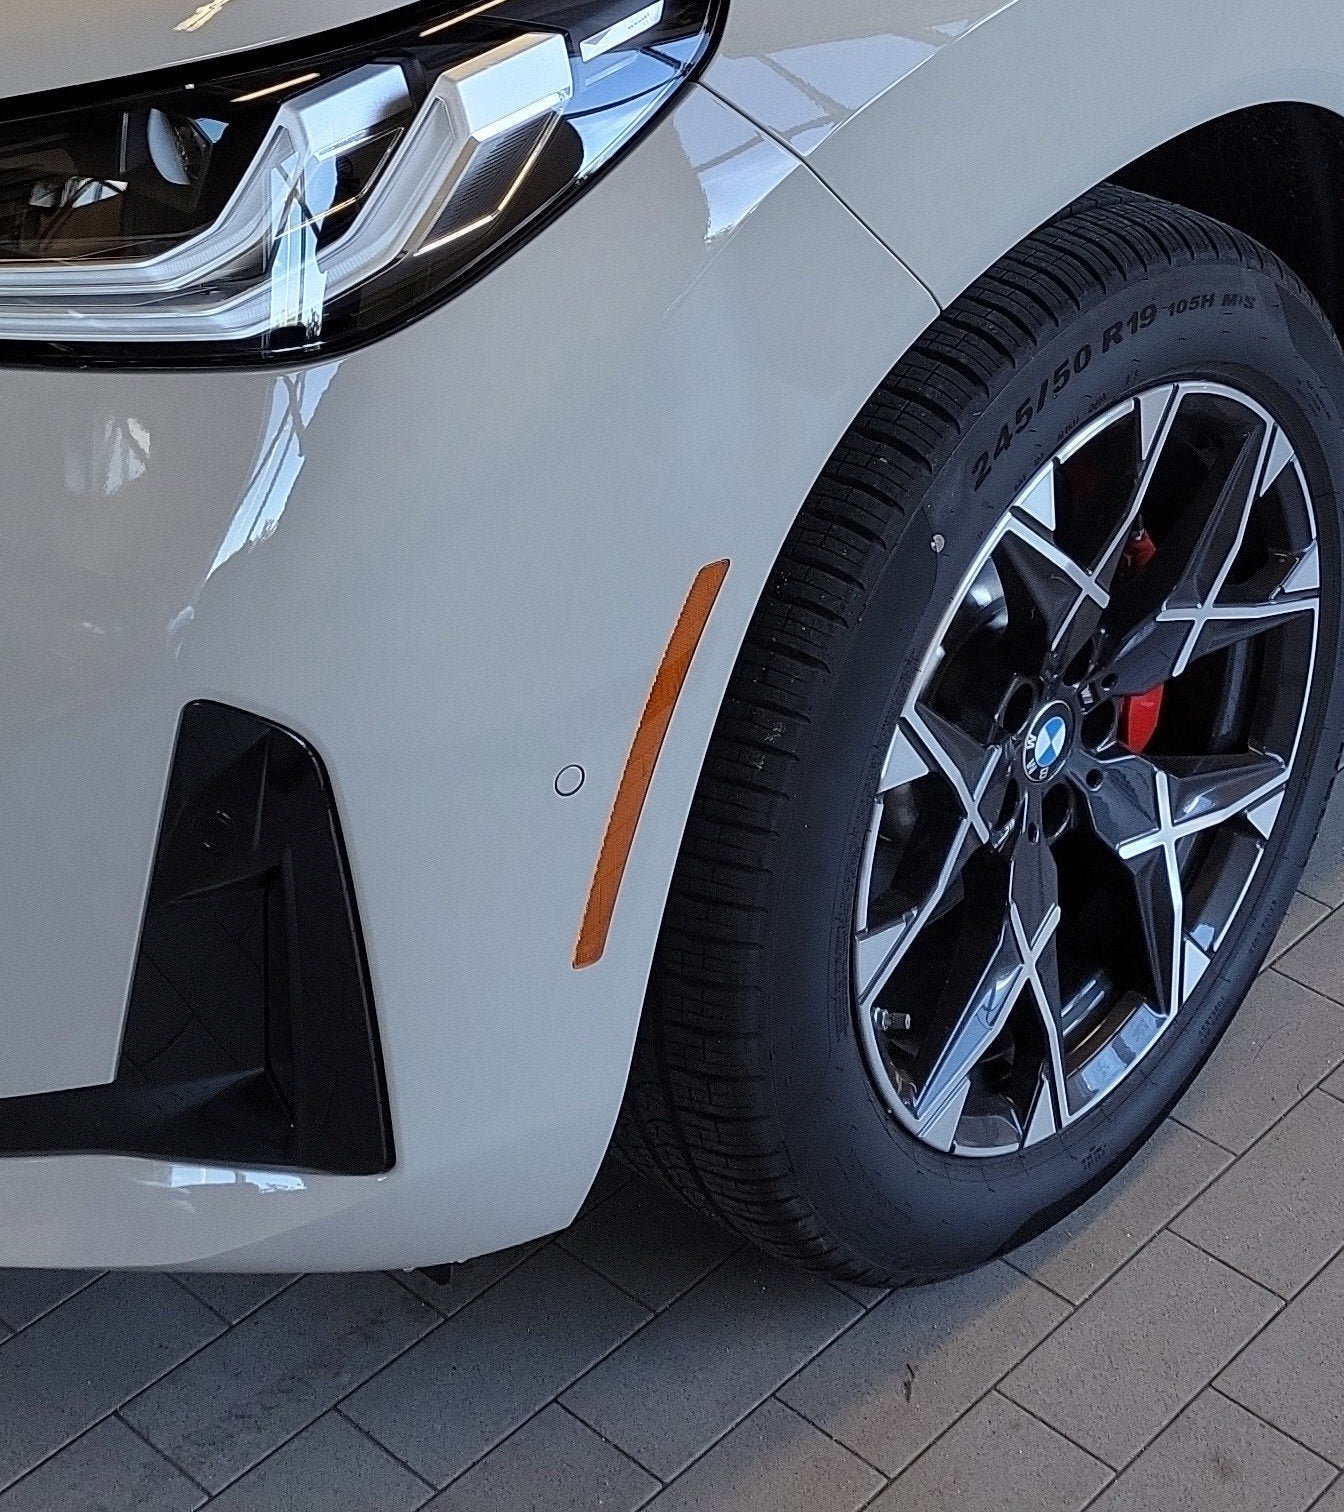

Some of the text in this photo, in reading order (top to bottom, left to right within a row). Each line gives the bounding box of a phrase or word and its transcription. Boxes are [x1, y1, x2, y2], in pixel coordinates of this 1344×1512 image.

[971, 343, 1092, 492] 245/50
[1101, 303, 1158, 355] R19
[1168, 293, 1215, 316] 105H
[1025, 733, 1050, 781] BMW
